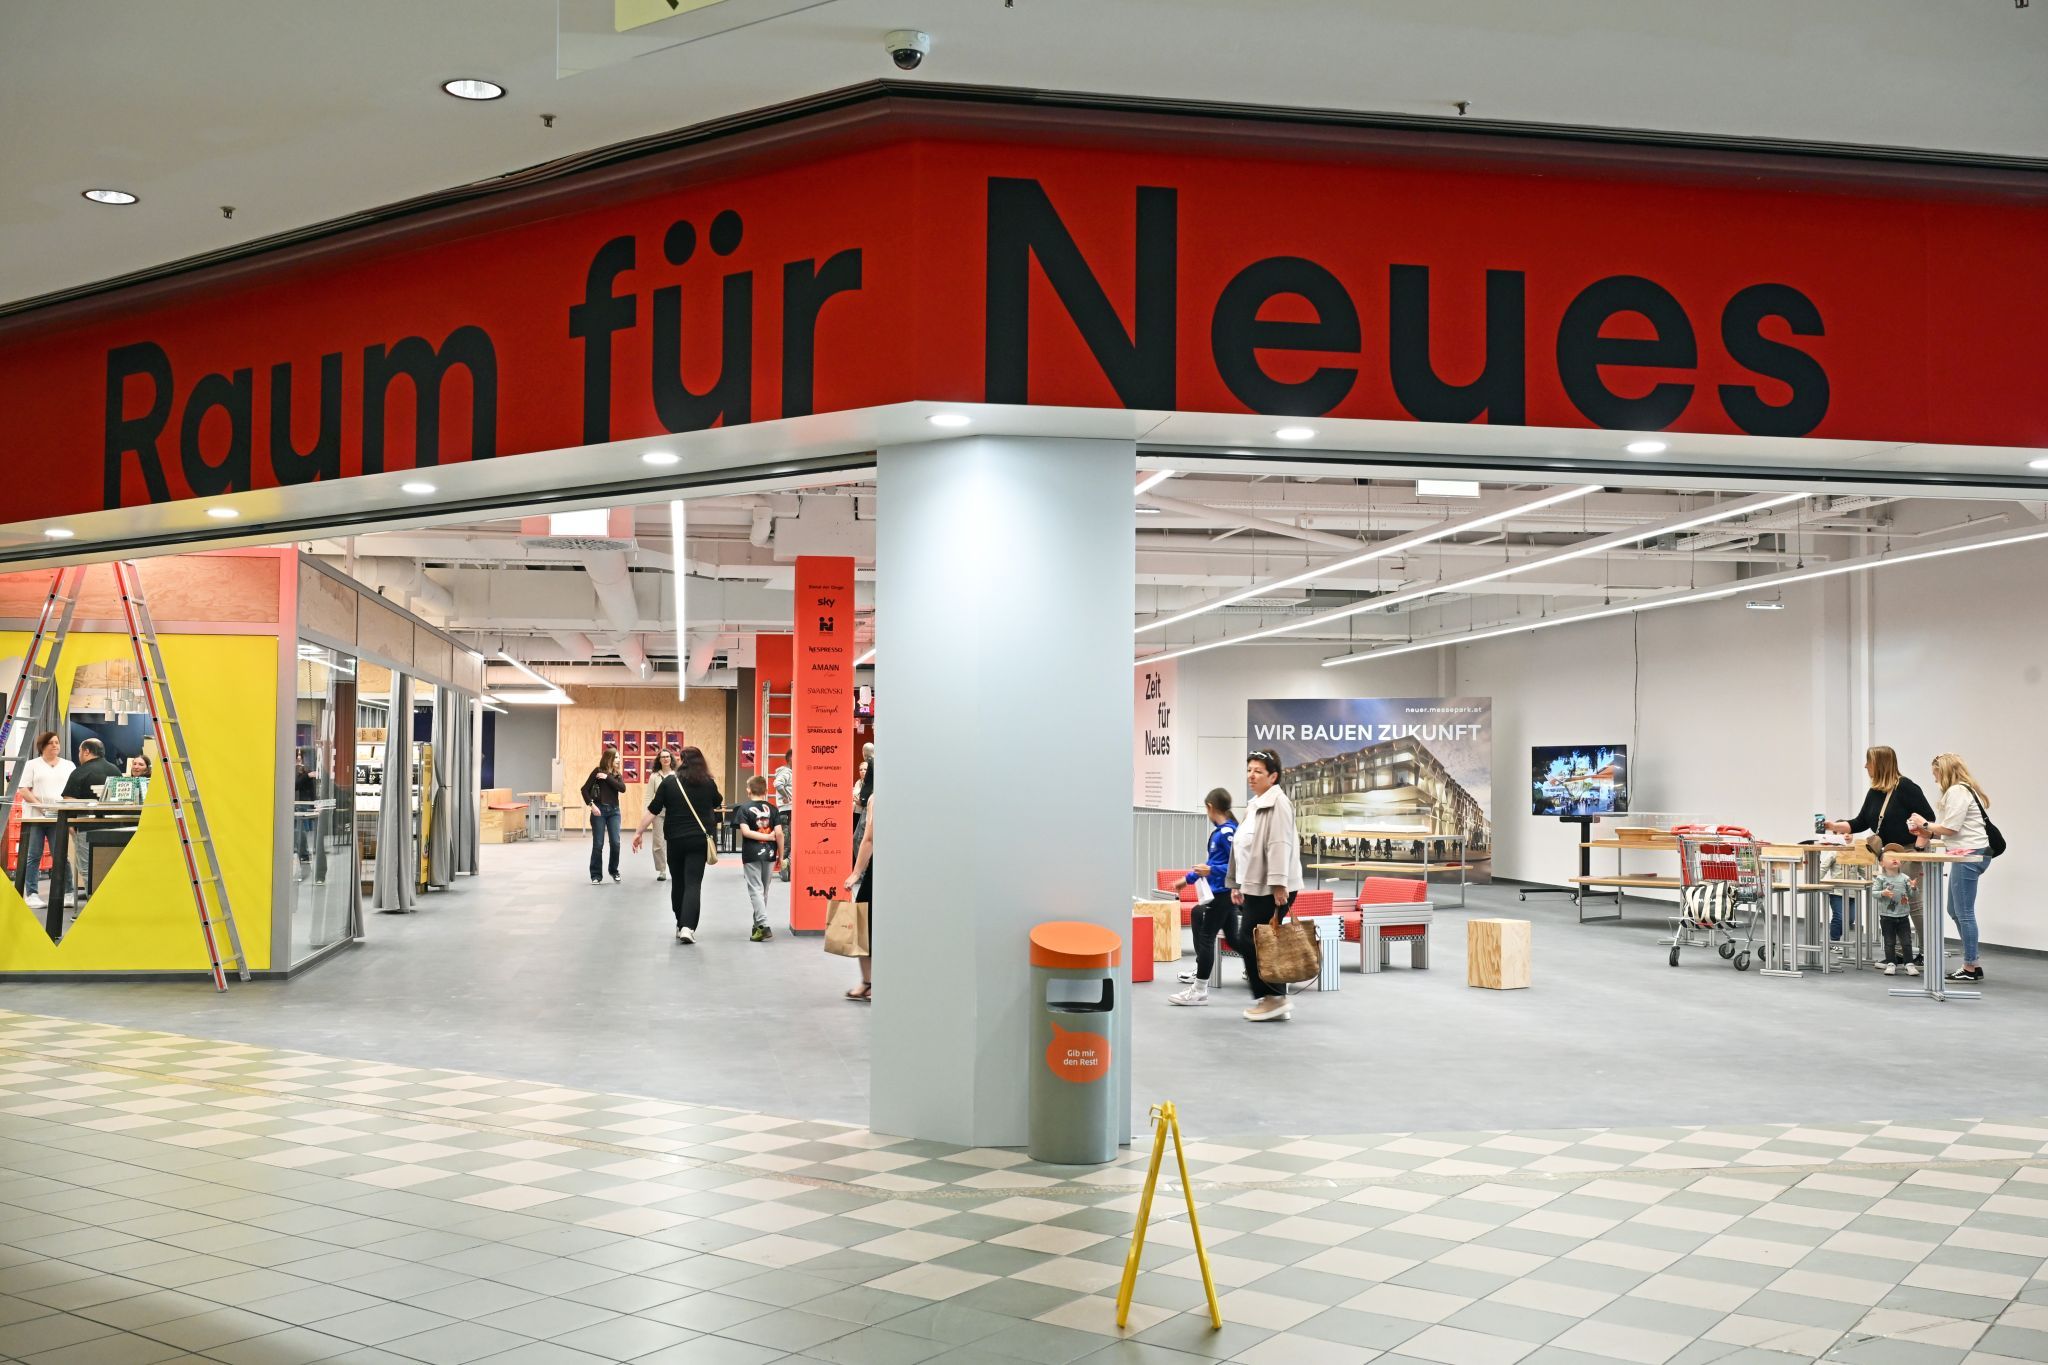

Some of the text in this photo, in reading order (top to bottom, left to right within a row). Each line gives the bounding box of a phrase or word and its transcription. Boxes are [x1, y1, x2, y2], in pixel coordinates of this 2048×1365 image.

[104, 176, 1831, 509] Raum für Neues
[817, 597, 835, 608] sky
[811, 663, 840, 671] AMANN
[1145, 672, 1161, 700] Zeit
[1158, 702, 1170, 729] für
[1254, 724, 1482, 741] WIR BAUEN ZUKUNFT
[1145, 730, 1170, 756] Neues
[1063, 1057, 1078, 1066] den
[1067, 1049, 1095, 1057] Gib mir
